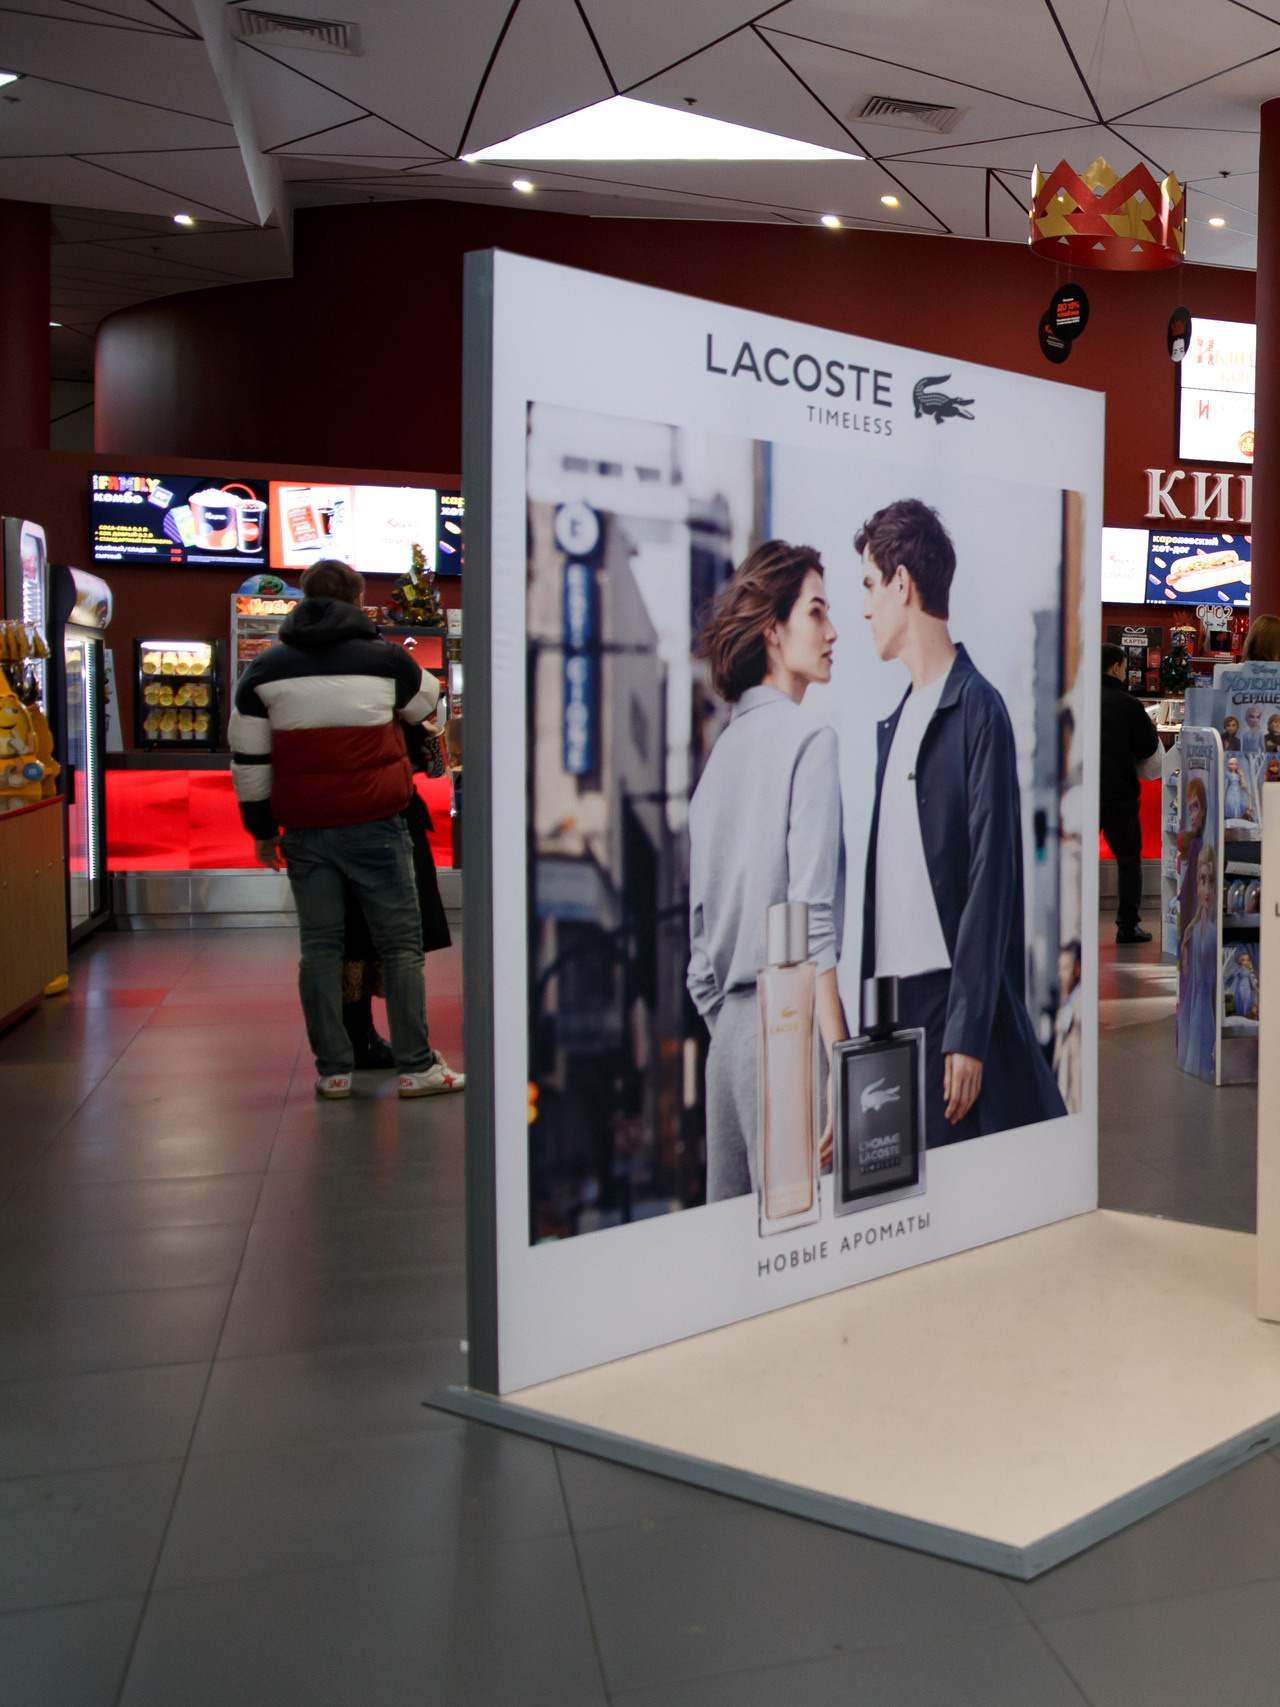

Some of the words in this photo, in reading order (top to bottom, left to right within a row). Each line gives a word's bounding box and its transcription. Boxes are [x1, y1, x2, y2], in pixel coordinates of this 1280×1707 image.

[706, 333, 892, 408] LACOSTE
[806, 405, 893, 436] TIMELESS
[98, 475, 161, 493] FAMILY
[93, 491, 144, 504] комбо
[1151, 544, 1190, 555] хот-дог
[250, 598, 298, 614] Nacho
[1250, 663, 1278, 676] Disney
[1231, 692, 1280, 706] СЕРДЦЕ
[859, 1145, 900, 1165] LACOSTE
[757, 1240, 828, 1278] НОВЫЕ
[840, 1212, 931, 1253] АРОМАТЫ
